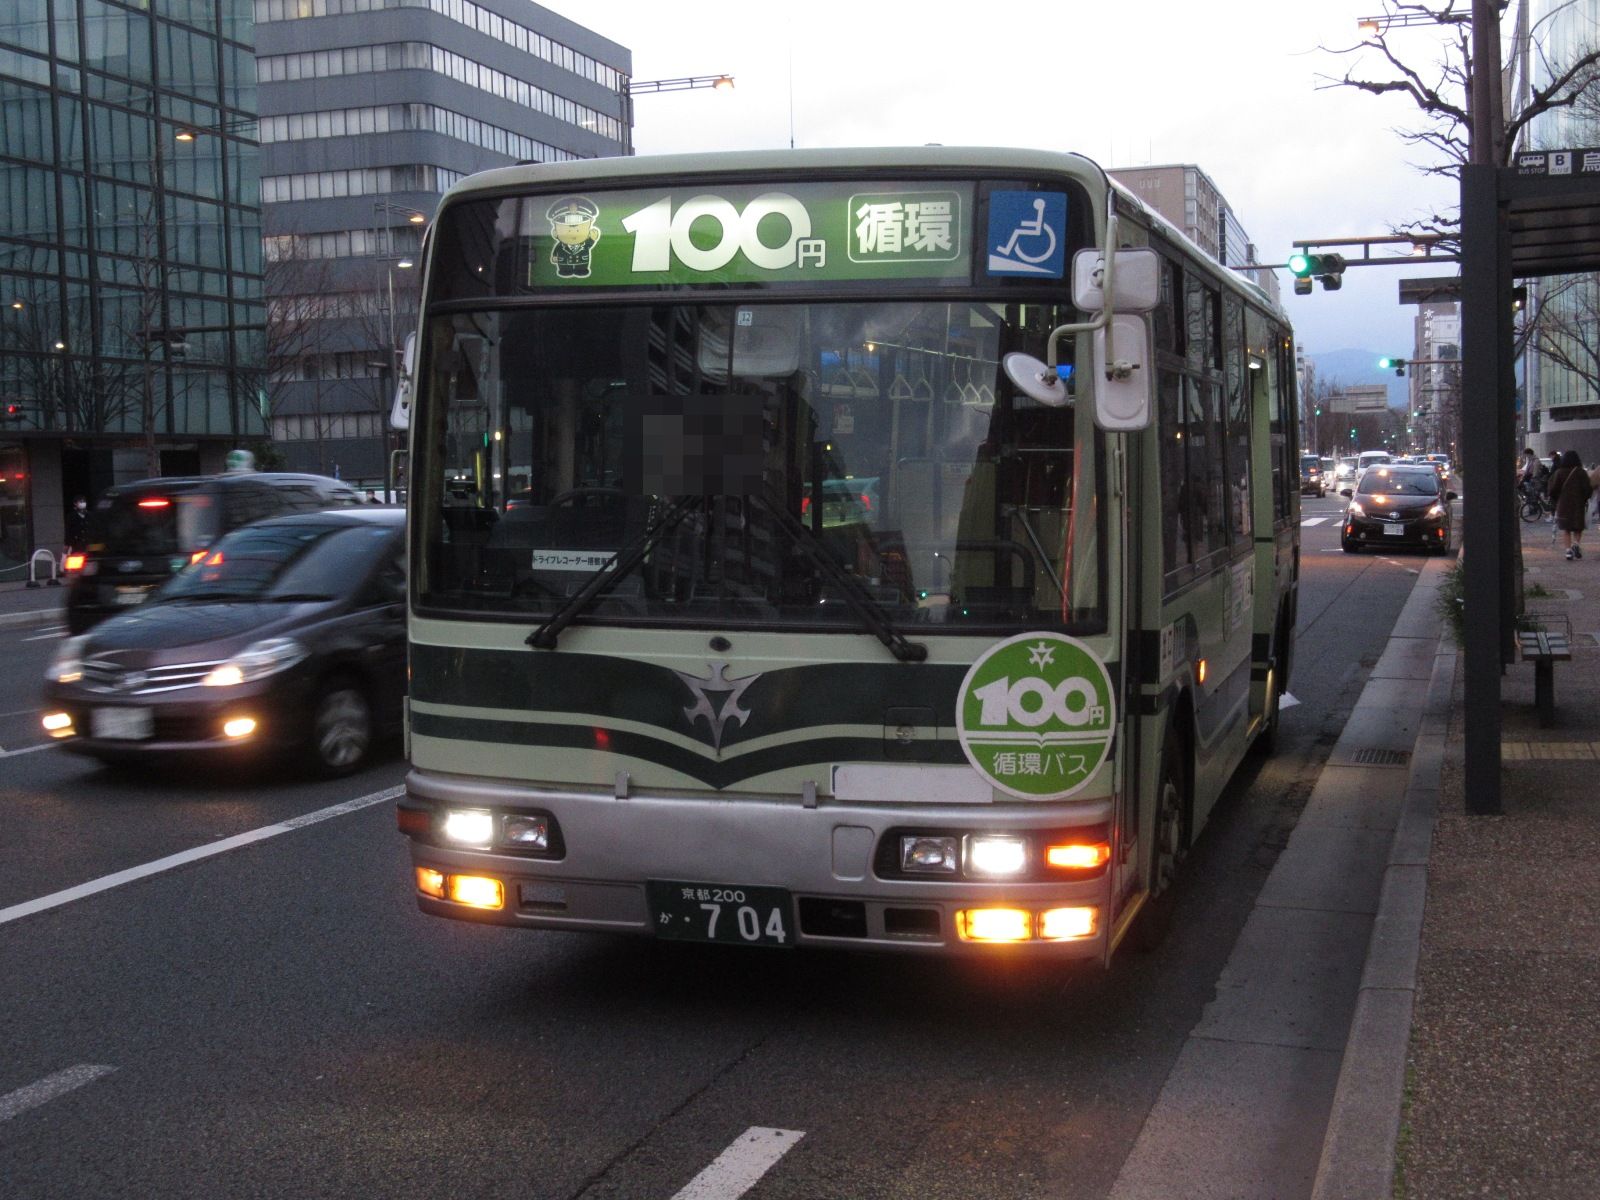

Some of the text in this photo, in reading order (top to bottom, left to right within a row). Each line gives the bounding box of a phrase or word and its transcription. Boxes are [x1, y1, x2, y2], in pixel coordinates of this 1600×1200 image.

[1555, 155, 1565, 166] B
[855, 201, 953, 254] 循環
[993, 752, 1088, 775] 循環バス
